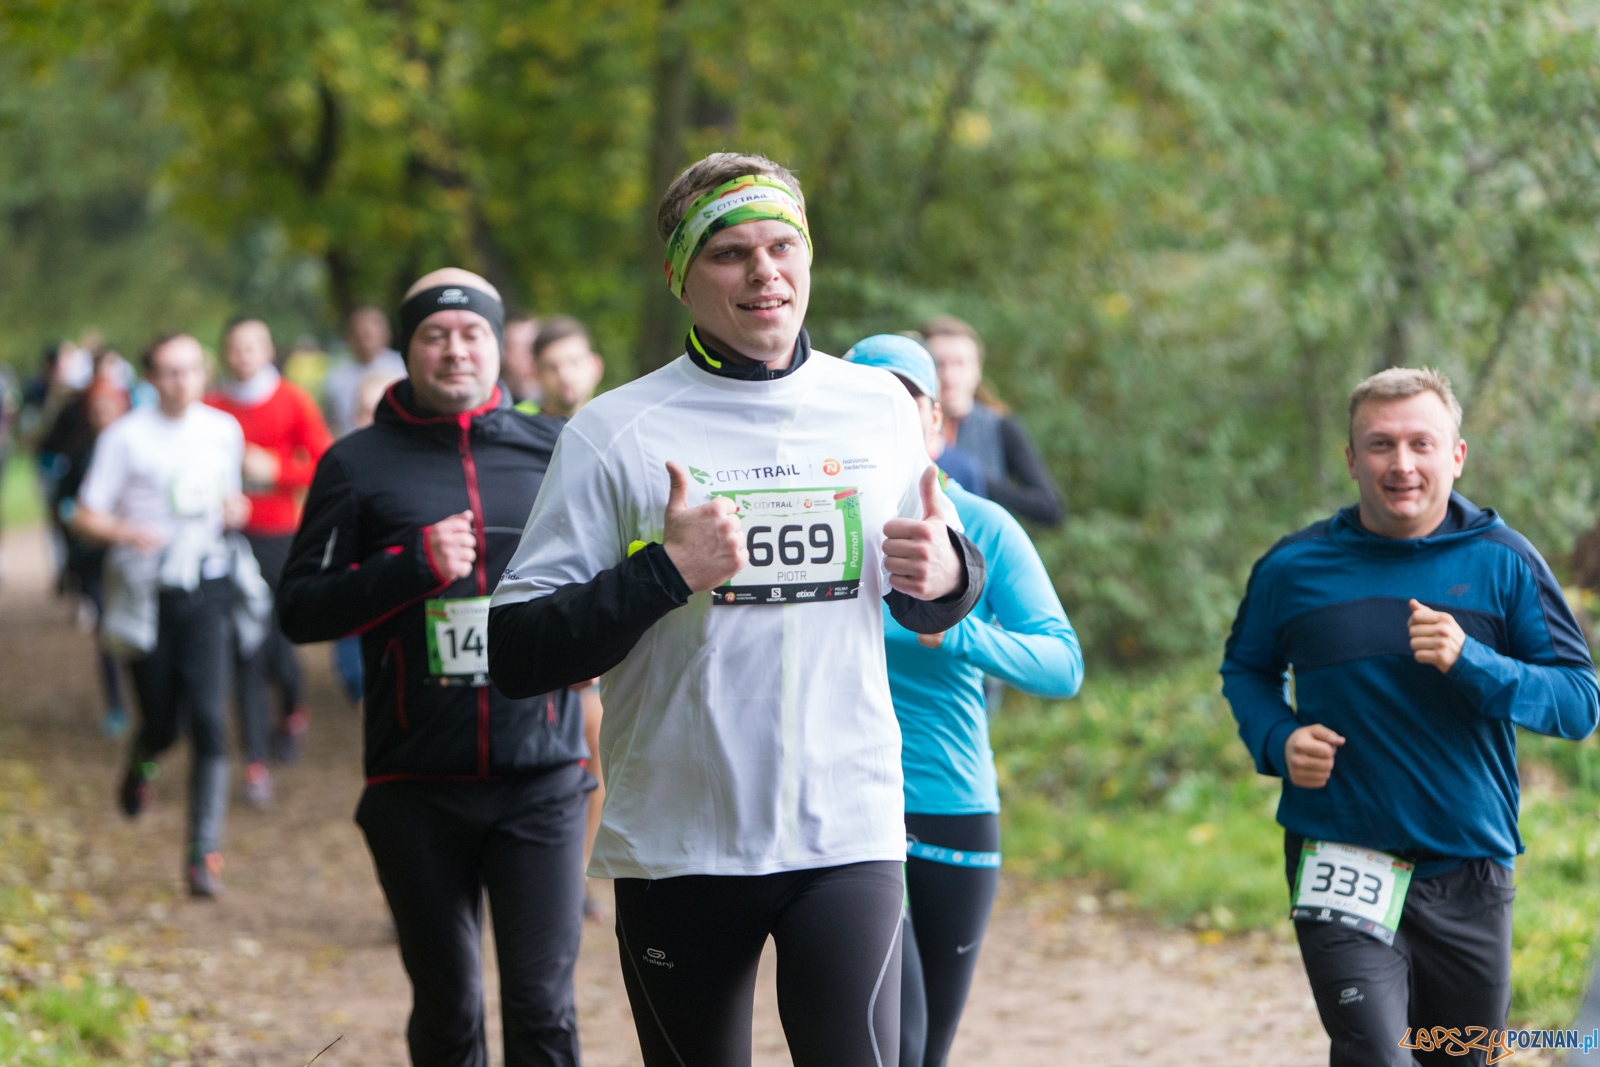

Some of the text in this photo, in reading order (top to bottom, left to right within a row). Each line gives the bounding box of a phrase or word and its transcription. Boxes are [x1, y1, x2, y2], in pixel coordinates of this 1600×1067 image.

[746, 523, 834, 567] 669
[850, 531, 858, 568] Poznań
[777, 570, 807, 582] PIOTR
[1311, 862, 1382, 905] 333
[642, 955, 674, 969] Kalenji
